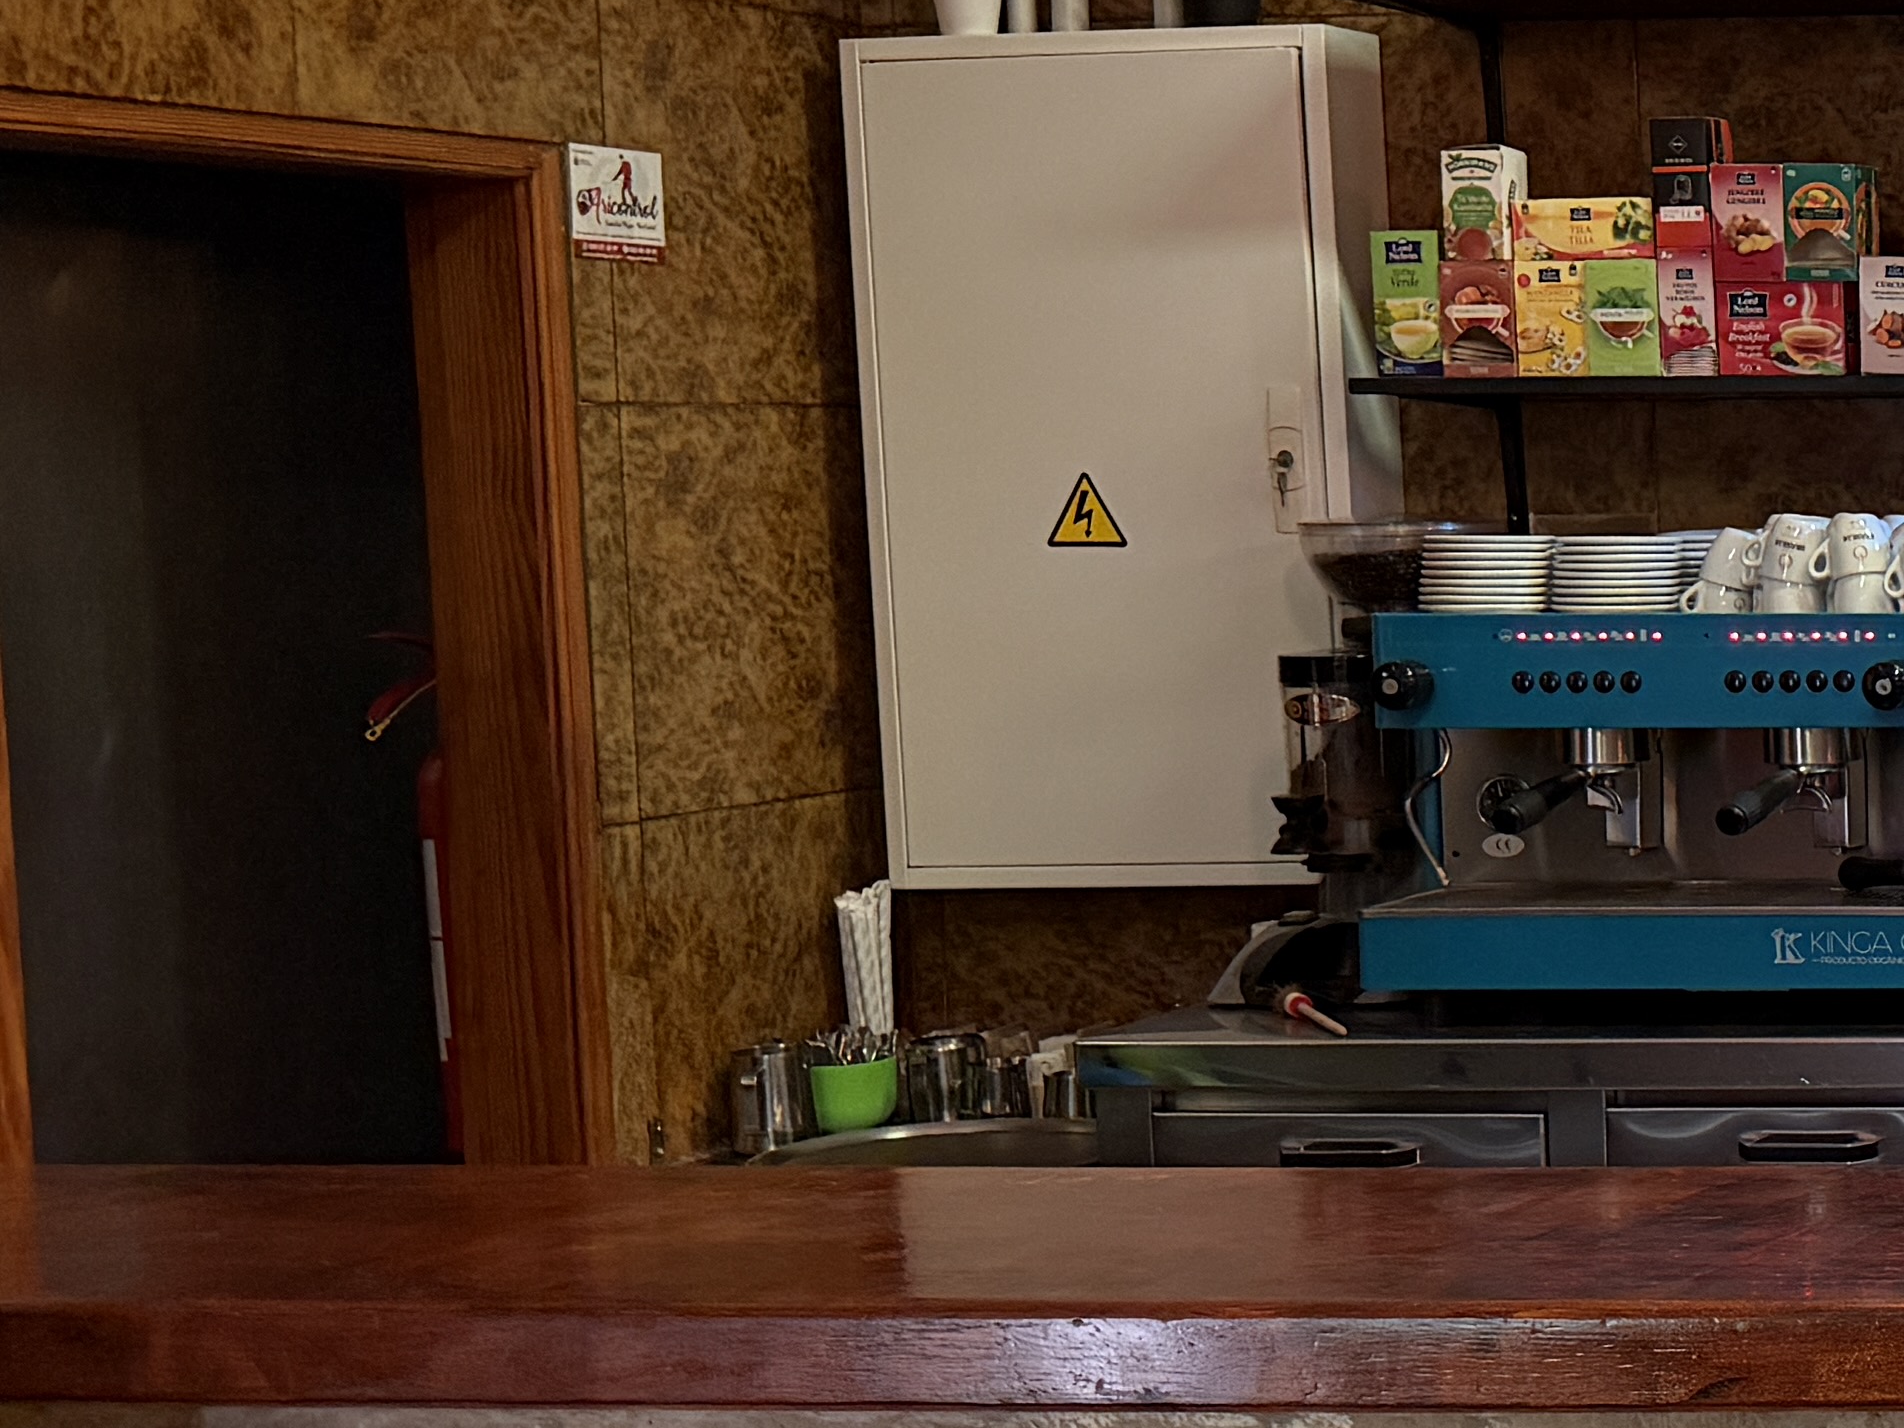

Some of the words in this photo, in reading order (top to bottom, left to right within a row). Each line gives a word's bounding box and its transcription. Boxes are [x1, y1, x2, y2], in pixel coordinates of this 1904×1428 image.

[1392, 242, 1412, 253] Lord
[1388, 252, 1419, 261] Nelson
[1738, 297, 1759, 305] Lord
[1732, 305, 1764, 314] Nelson
[1733, 321, 1765, 331] English
[1728, 332, 1771, 343] Breakfast
[1810, 931, 1893, 954] KINGA
